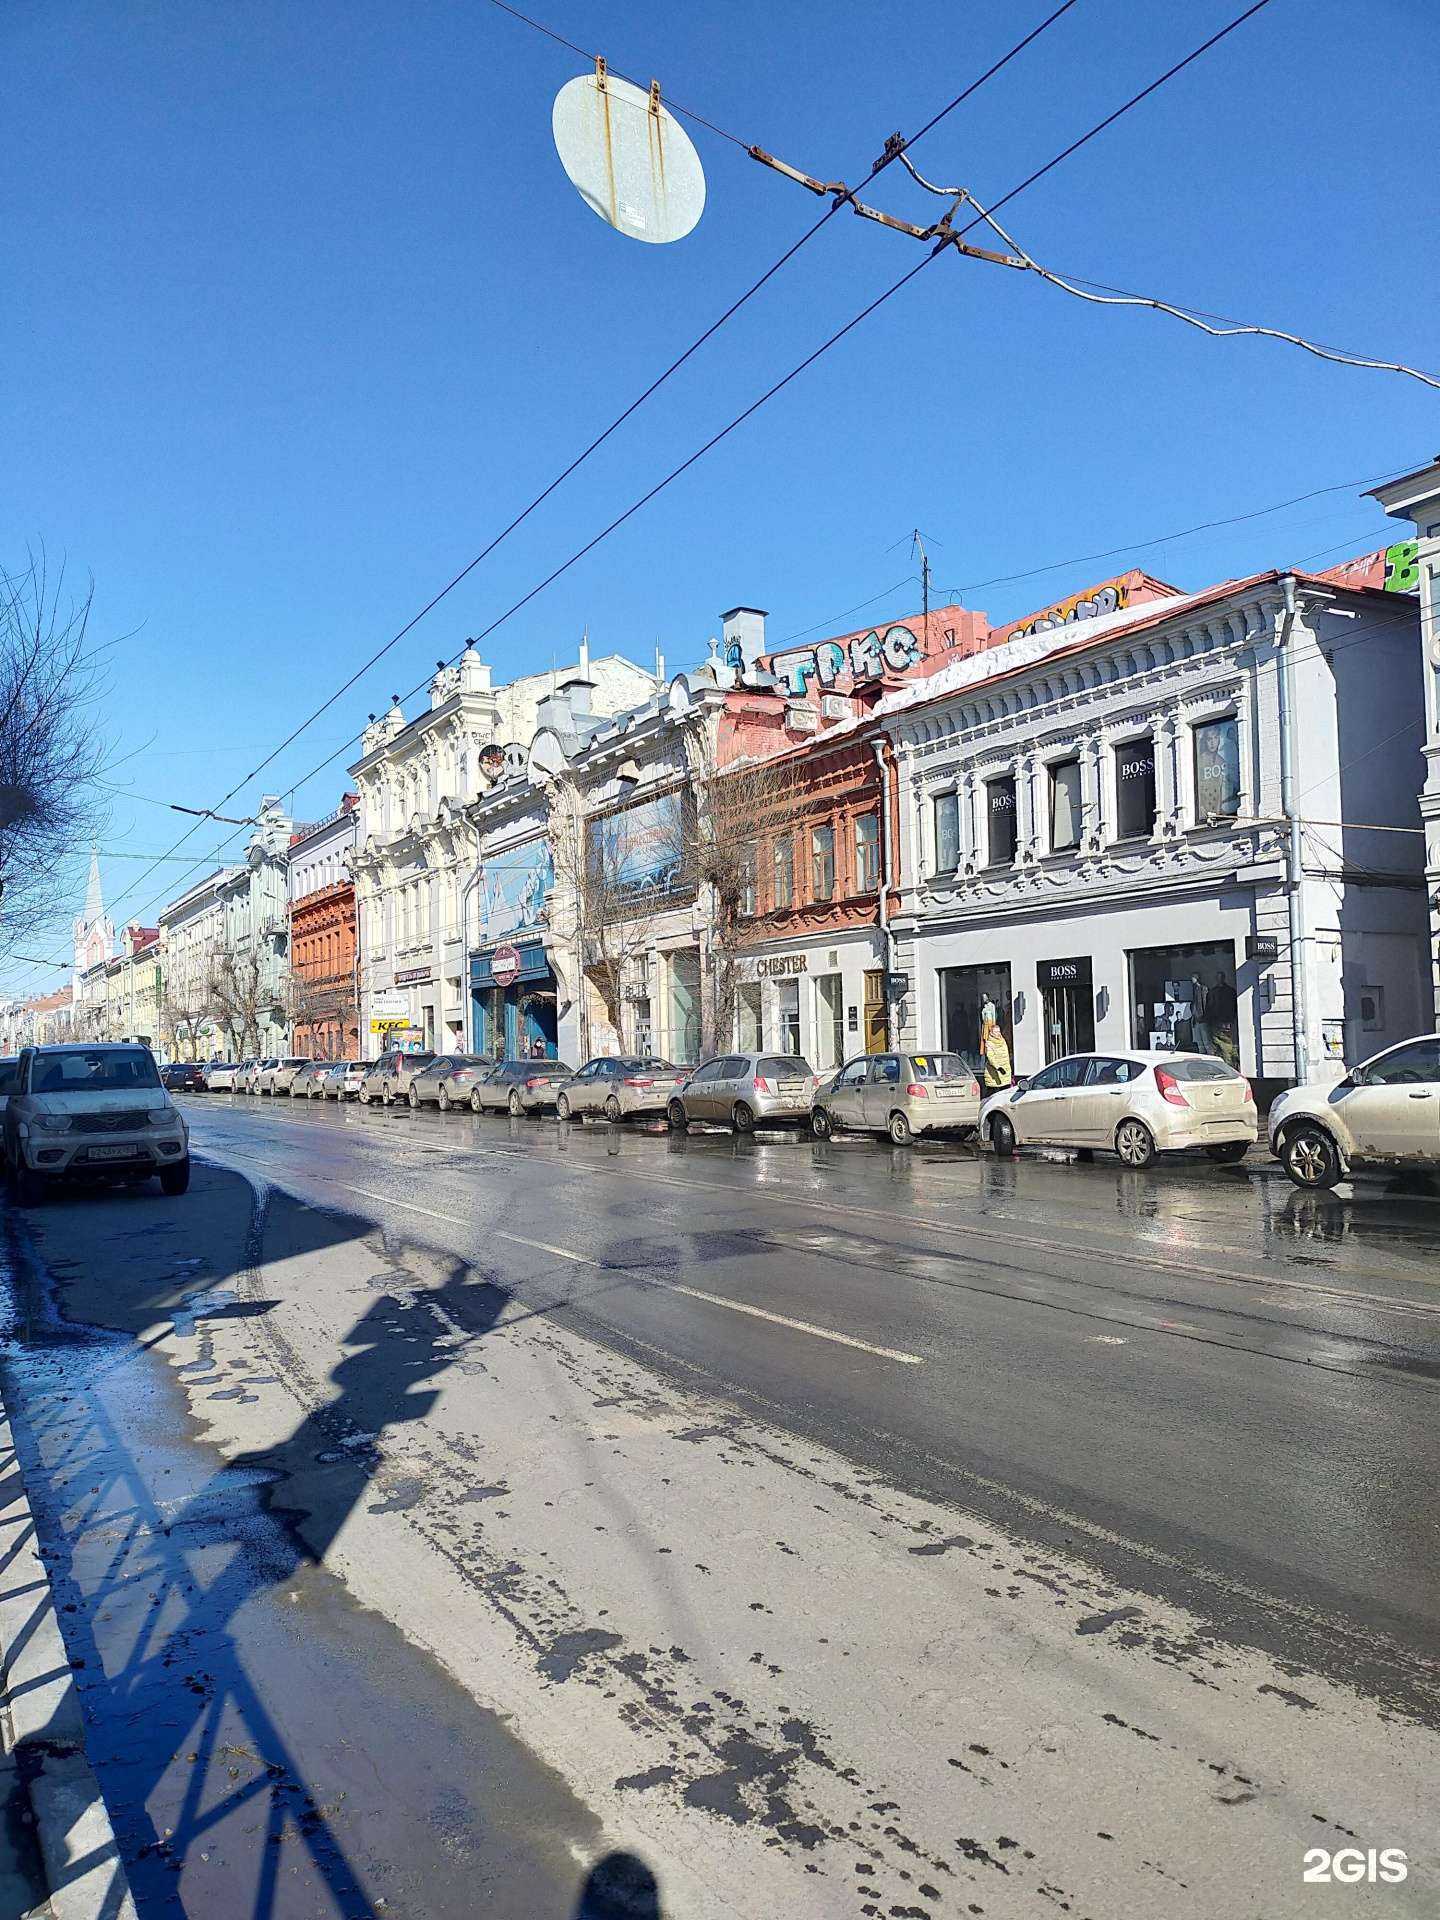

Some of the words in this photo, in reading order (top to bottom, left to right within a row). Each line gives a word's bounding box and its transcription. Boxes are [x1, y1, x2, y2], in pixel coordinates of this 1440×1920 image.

[1122, 758, 1154, 776] BOSS
[1257, 942, 1275, 951] BOSS
[756, 954, 808, 978] CHESTER
[1051, 964, 1077, 977] BOSS
[890, 977, 906, 985] BOSS
